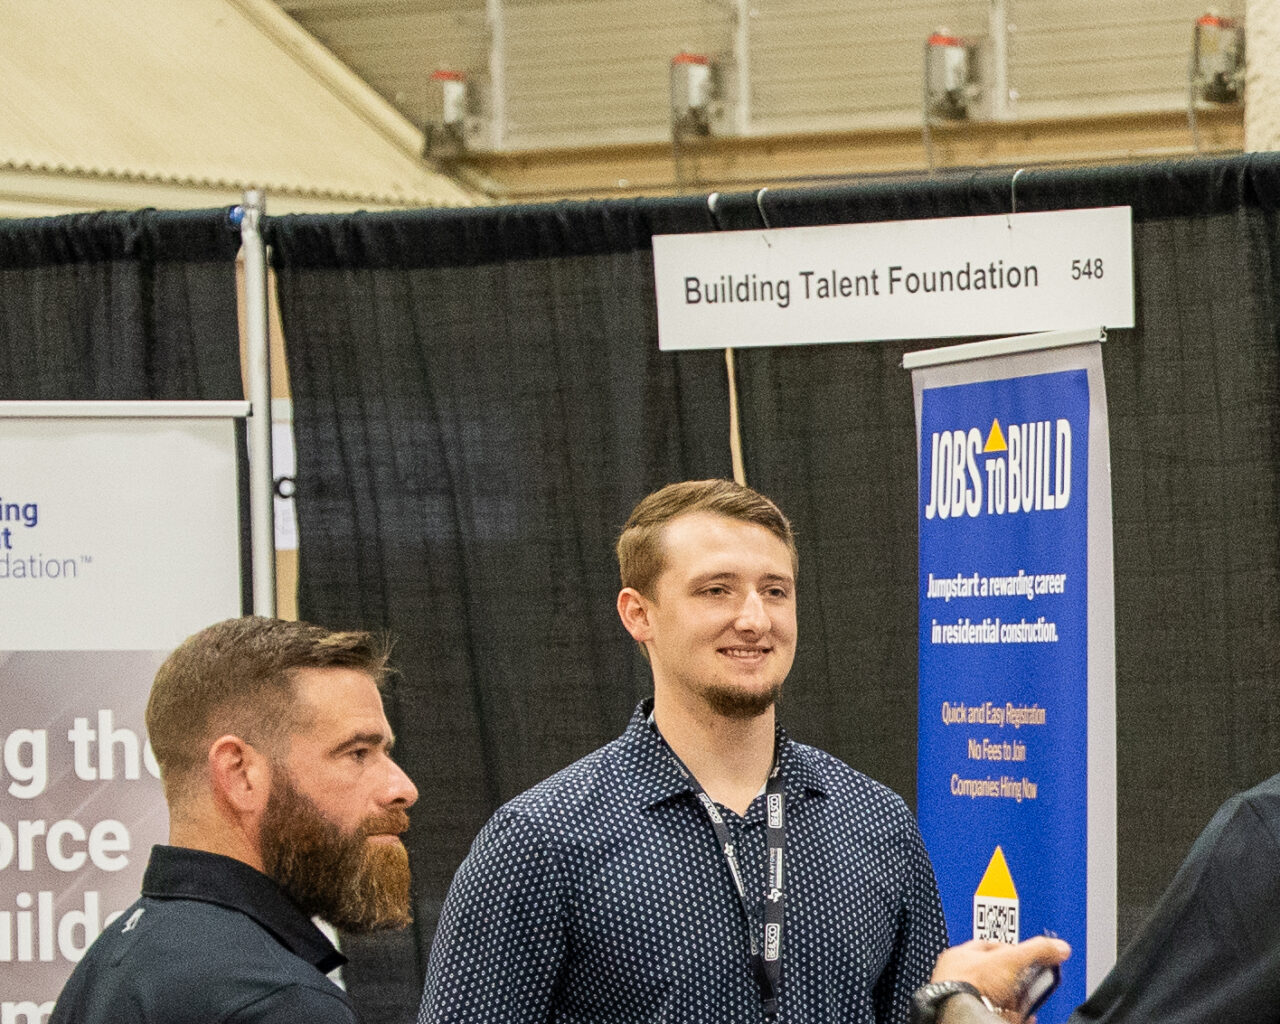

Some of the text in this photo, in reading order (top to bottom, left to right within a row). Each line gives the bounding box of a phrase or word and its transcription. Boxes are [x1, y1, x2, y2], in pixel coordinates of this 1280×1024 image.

[684, 258, 1104, 308] Building Talent Foundation 548
[925, 419, 1072, 520] JOBS TO BUILD
[927, 569, 1067, 602] Jumpstart a rewarding career
[932, 616, 1058, 644] in residential construction.
[942, 701, 1046, 729] Quick and Easy Registration
[968, 738, 1026, 761] No Fees to Join
[950, 773, 1037, 803] Companies Hiring Now
